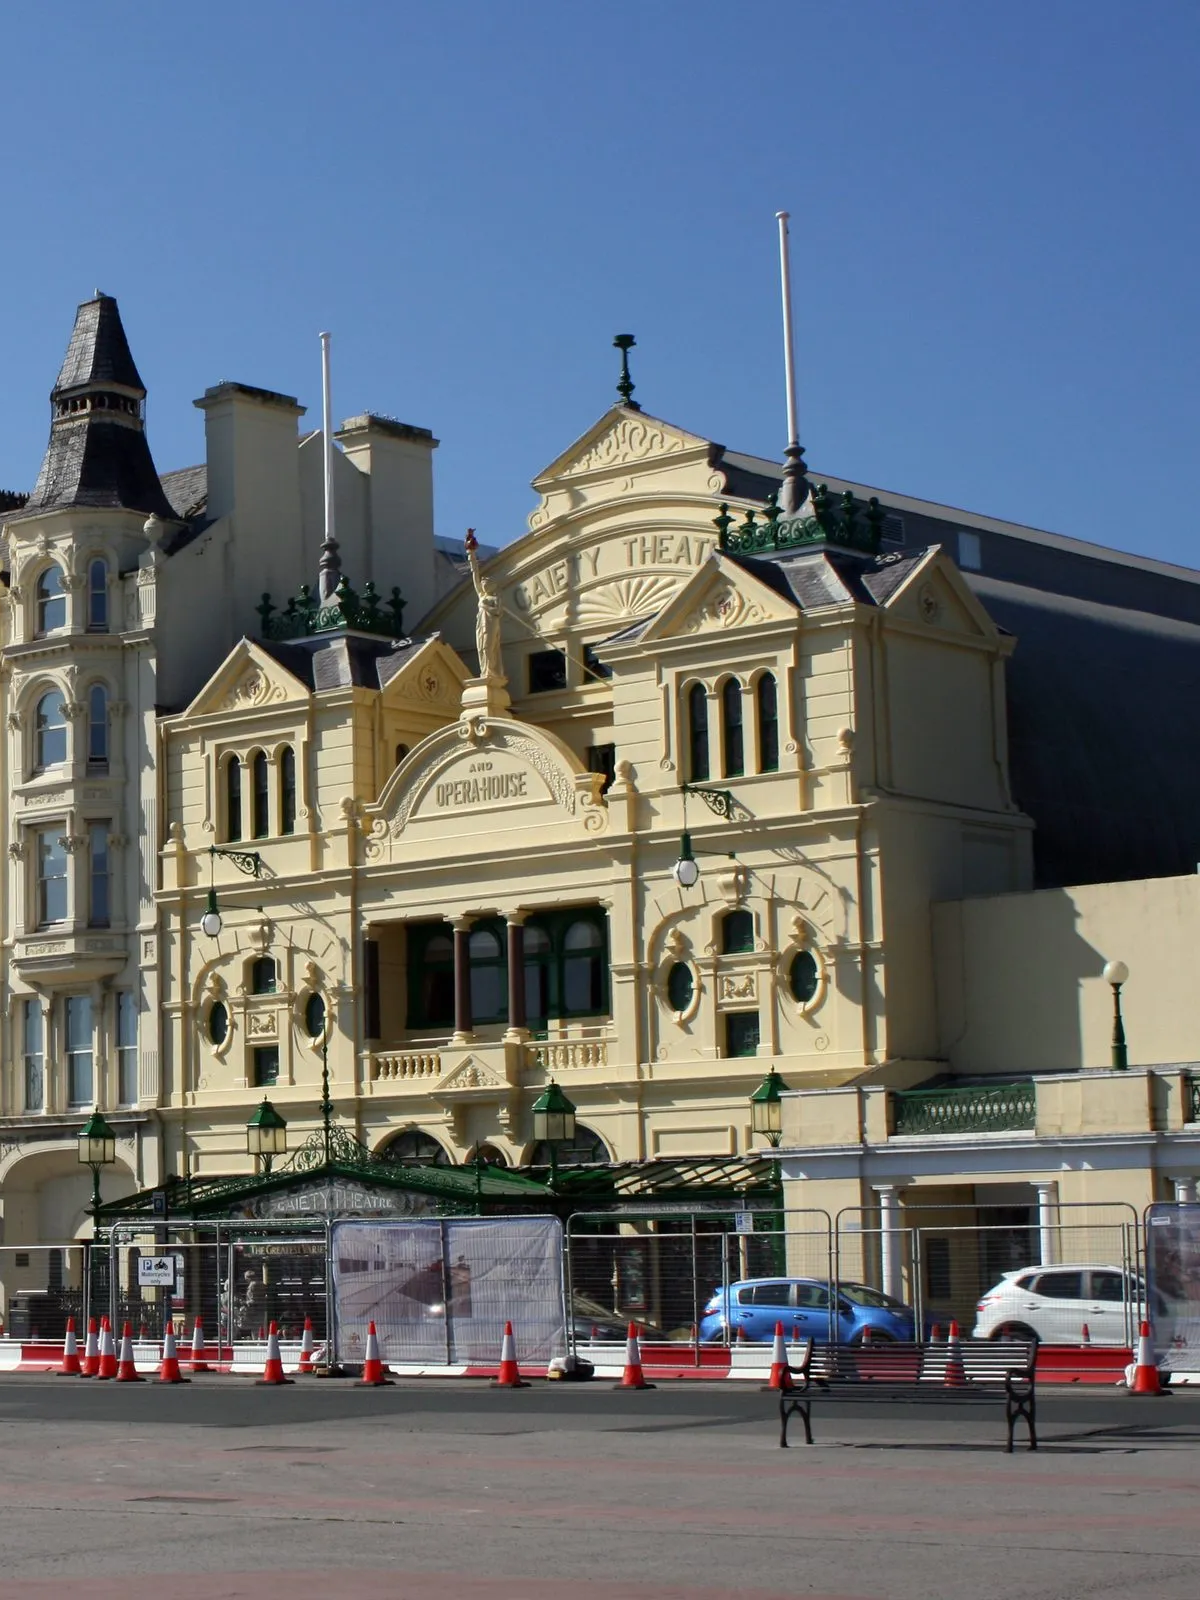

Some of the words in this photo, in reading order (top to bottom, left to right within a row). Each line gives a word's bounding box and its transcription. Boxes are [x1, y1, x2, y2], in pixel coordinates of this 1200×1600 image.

[514, 546, 600, 611] GAIETY
[469, 762, 493, 772] AND
[277, 1192, 330, 1211] GAIETY
[251, 1244, 265, 1255] THE
[144, 1261, 151, 1270] P
